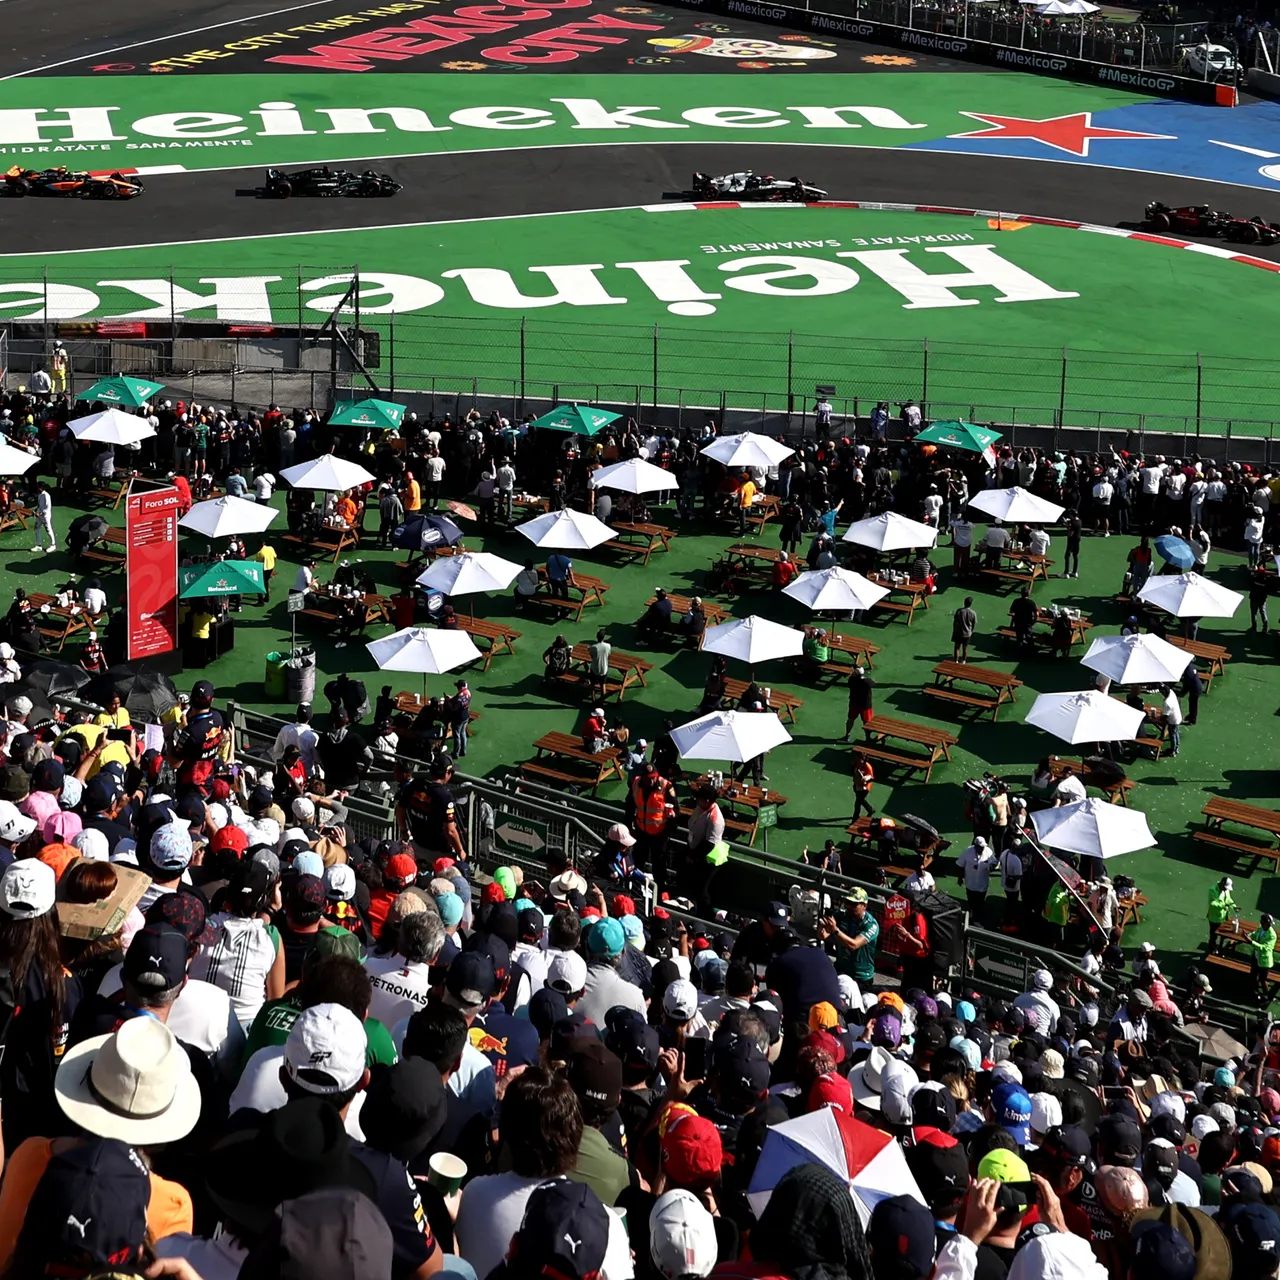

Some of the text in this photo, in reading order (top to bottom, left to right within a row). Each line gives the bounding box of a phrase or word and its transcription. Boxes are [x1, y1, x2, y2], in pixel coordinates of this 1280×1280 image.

[728, 0, 786, 20] #MexicoGP
[154, 49, 235, 68] THE
[224, 25, 300, 50] CITY
[287, 15, 353, 32] THAT
[357, 1, 425, 21] HAS
[812, 15, 874, 36] #MexicoGP
[480, 14, 665, 65] CITY
[900, 31, 968, 53] #MexicoGP
[996, 50, 1068, 71] #MexicoGP
[1098, 68, 1176, 91] #MexicoGP
[125, 139, 254, 150] SANAMENTE
[699, 238, 842, 254] SANAMENTE
[145, 496, 180, 509] Foro SOL
[369, 974, 428, 1007] PETRONAS
